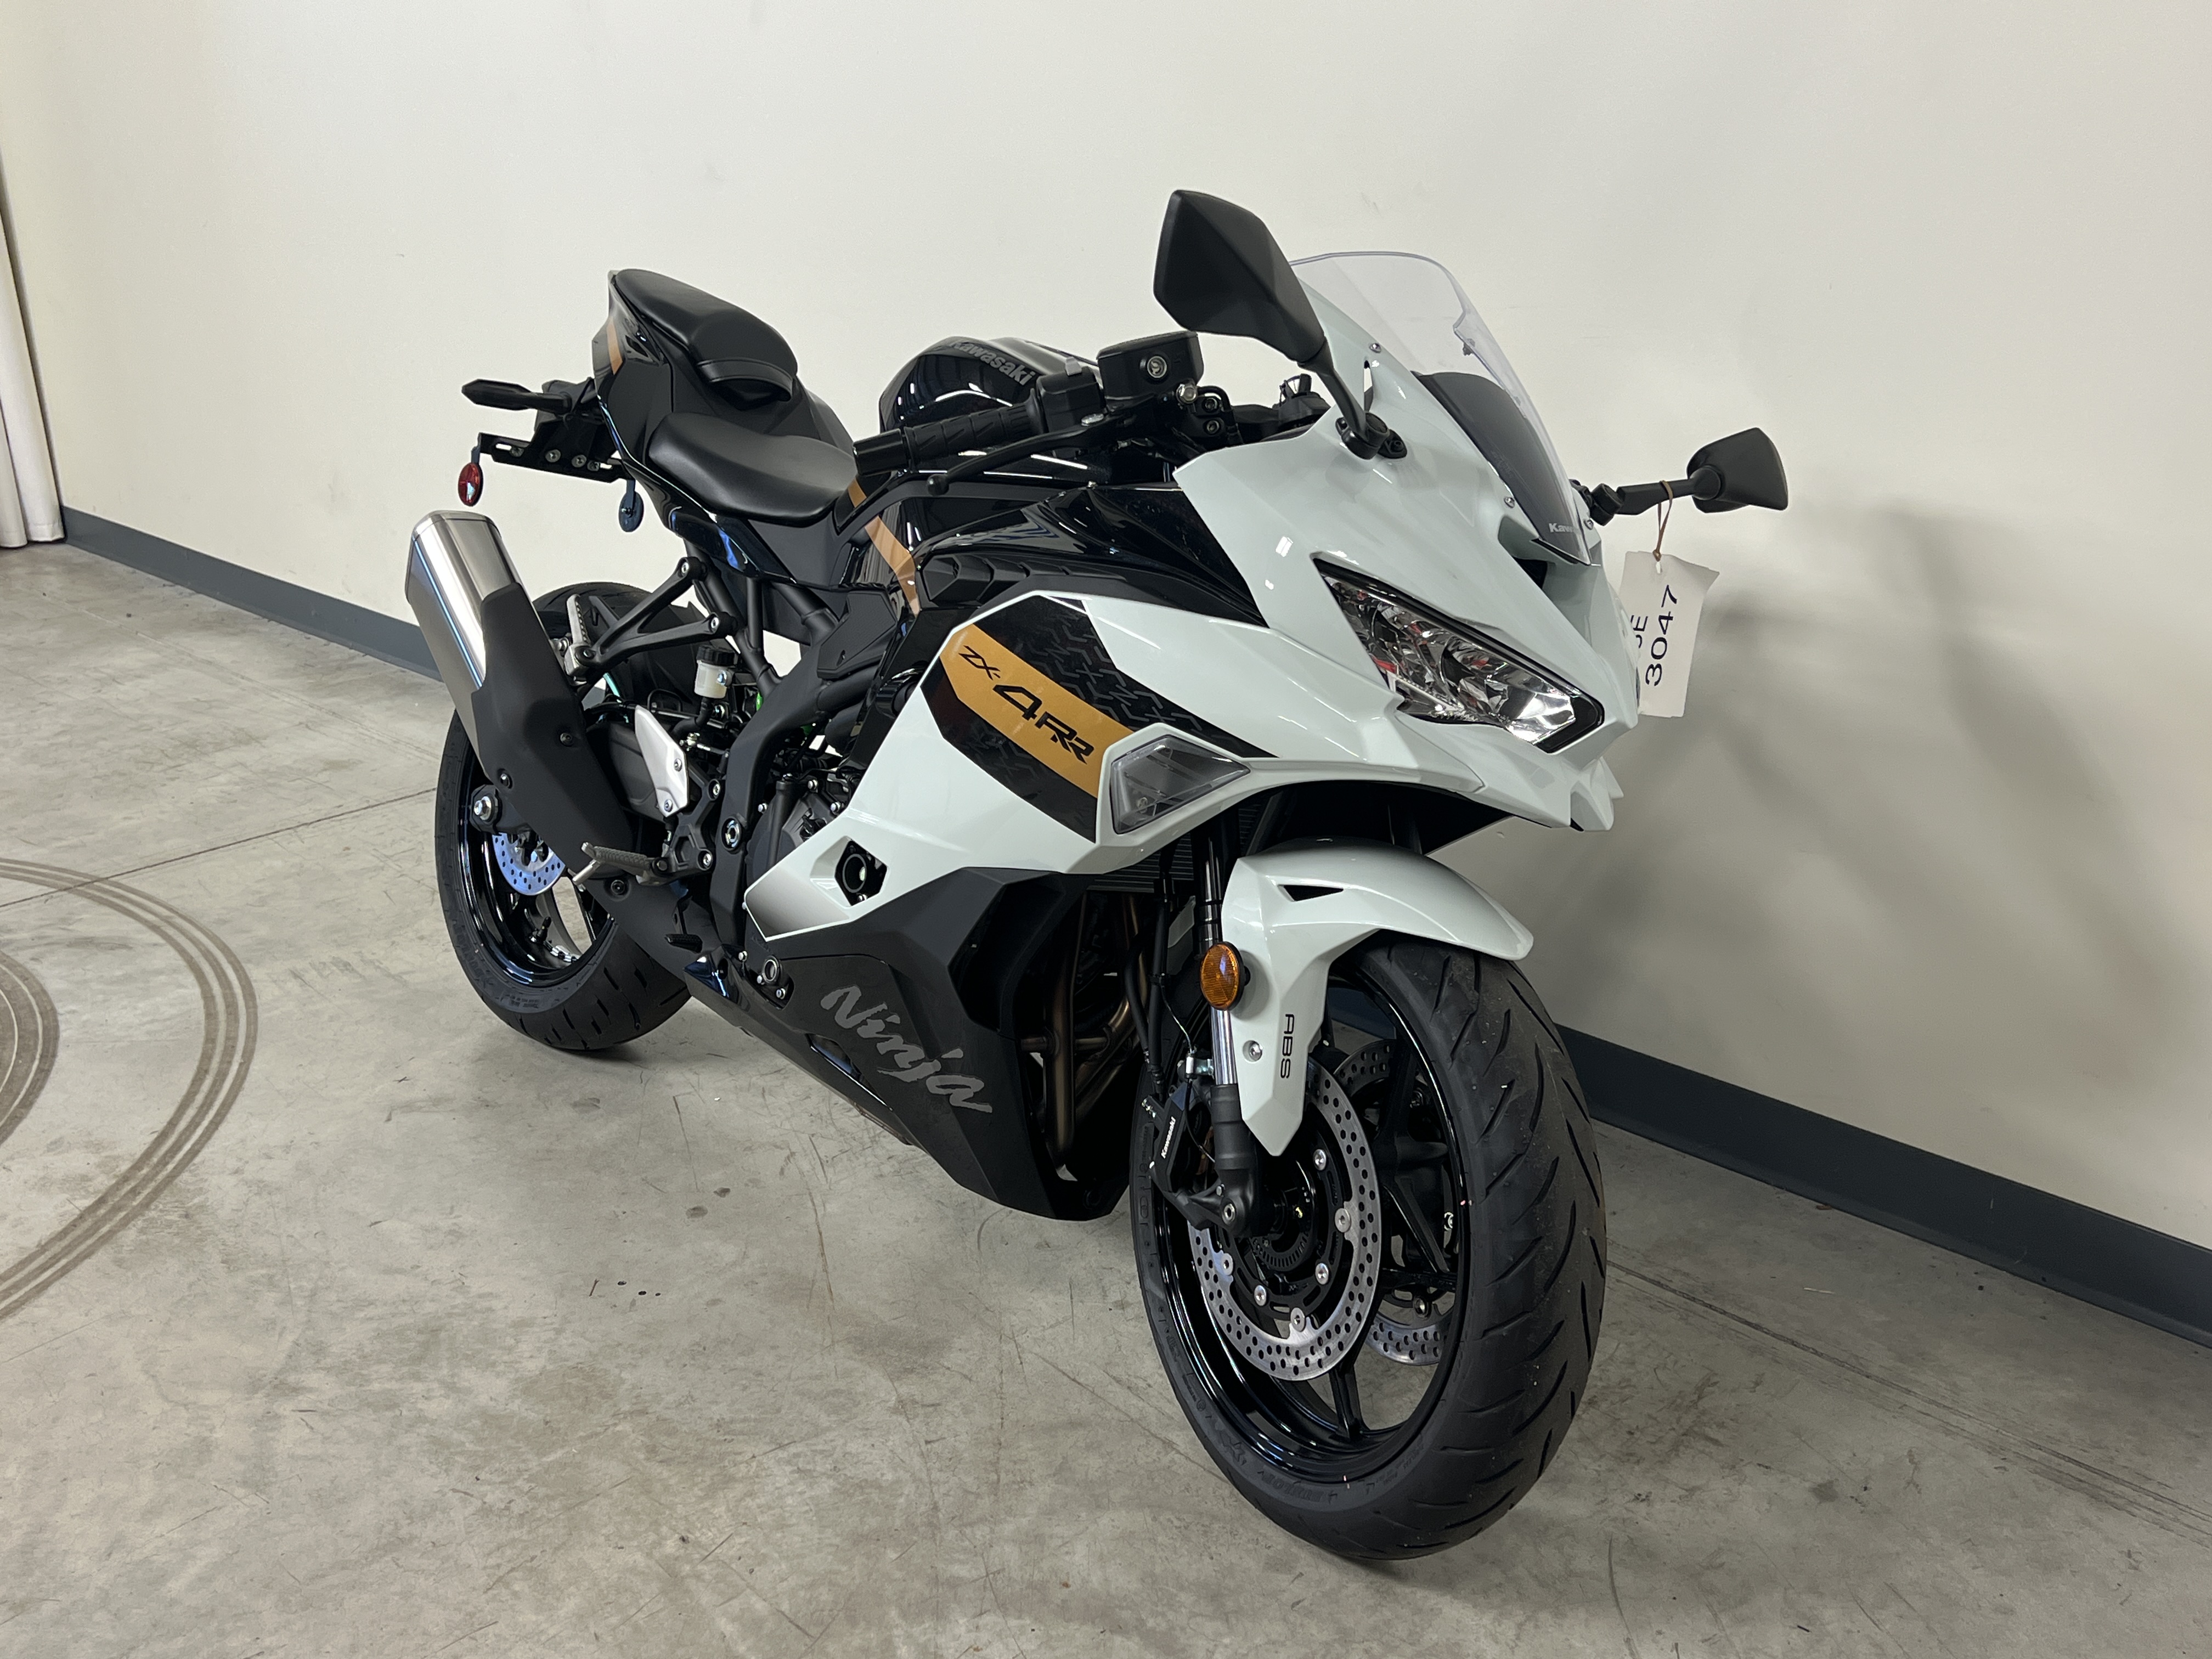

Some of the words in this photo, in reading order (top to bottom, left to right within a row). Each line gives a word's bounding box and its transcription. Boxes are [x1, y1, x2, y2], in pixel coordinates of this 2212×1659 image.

[950, 341, 1036, 386] Kawasaki
[1645, 584, 1678, 686] 3047
[820, 985, 993, 1113] Ninja
[1280, 1014, 1295, 1079] ABS
[1161, 1116, 1176, 1159] Kawasaki
